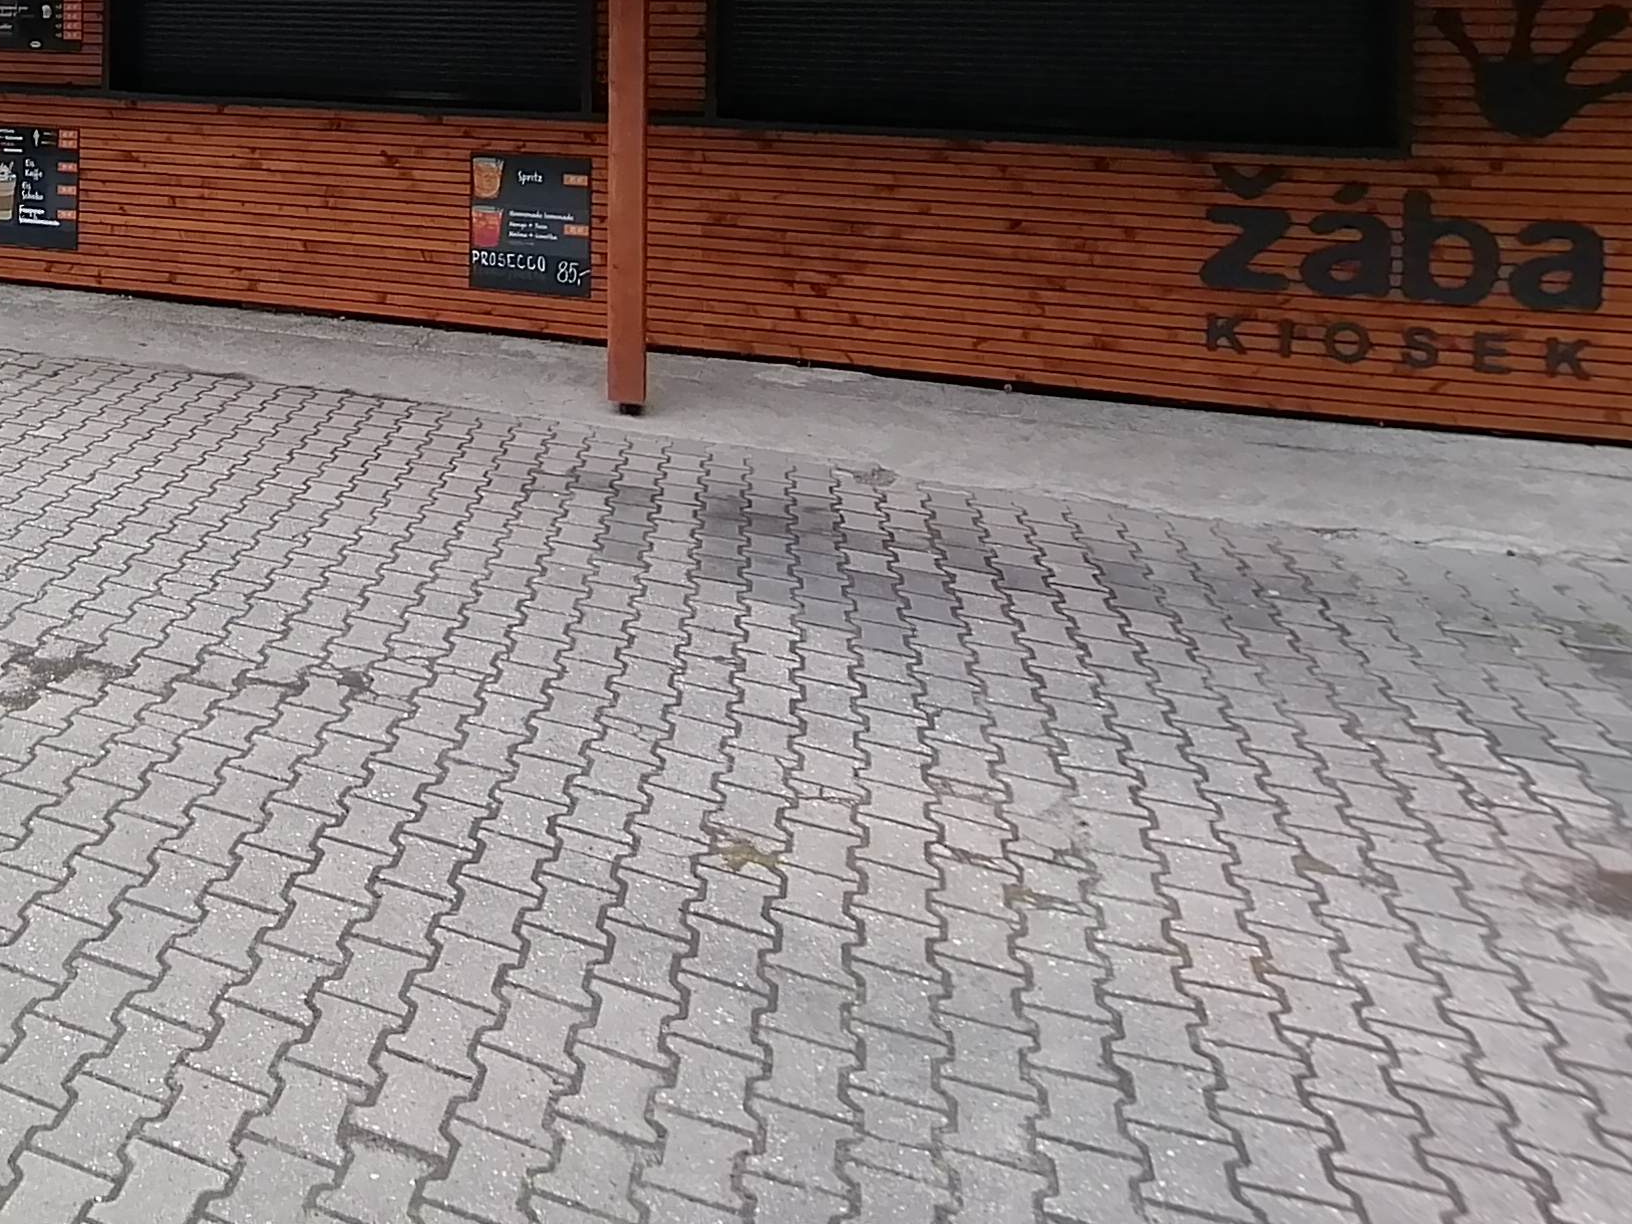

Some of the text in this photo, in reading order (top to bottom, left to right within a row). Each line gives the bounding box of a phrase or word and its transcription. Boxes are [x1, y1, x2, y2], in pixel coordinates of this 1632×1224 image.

[517, 170, 544, 186] Spritz
[1199, 163, 1605, 312] žába
[471, 250, 546, 272] PROSECCO
[1205, 313, 1593, 382] KIOSEK
